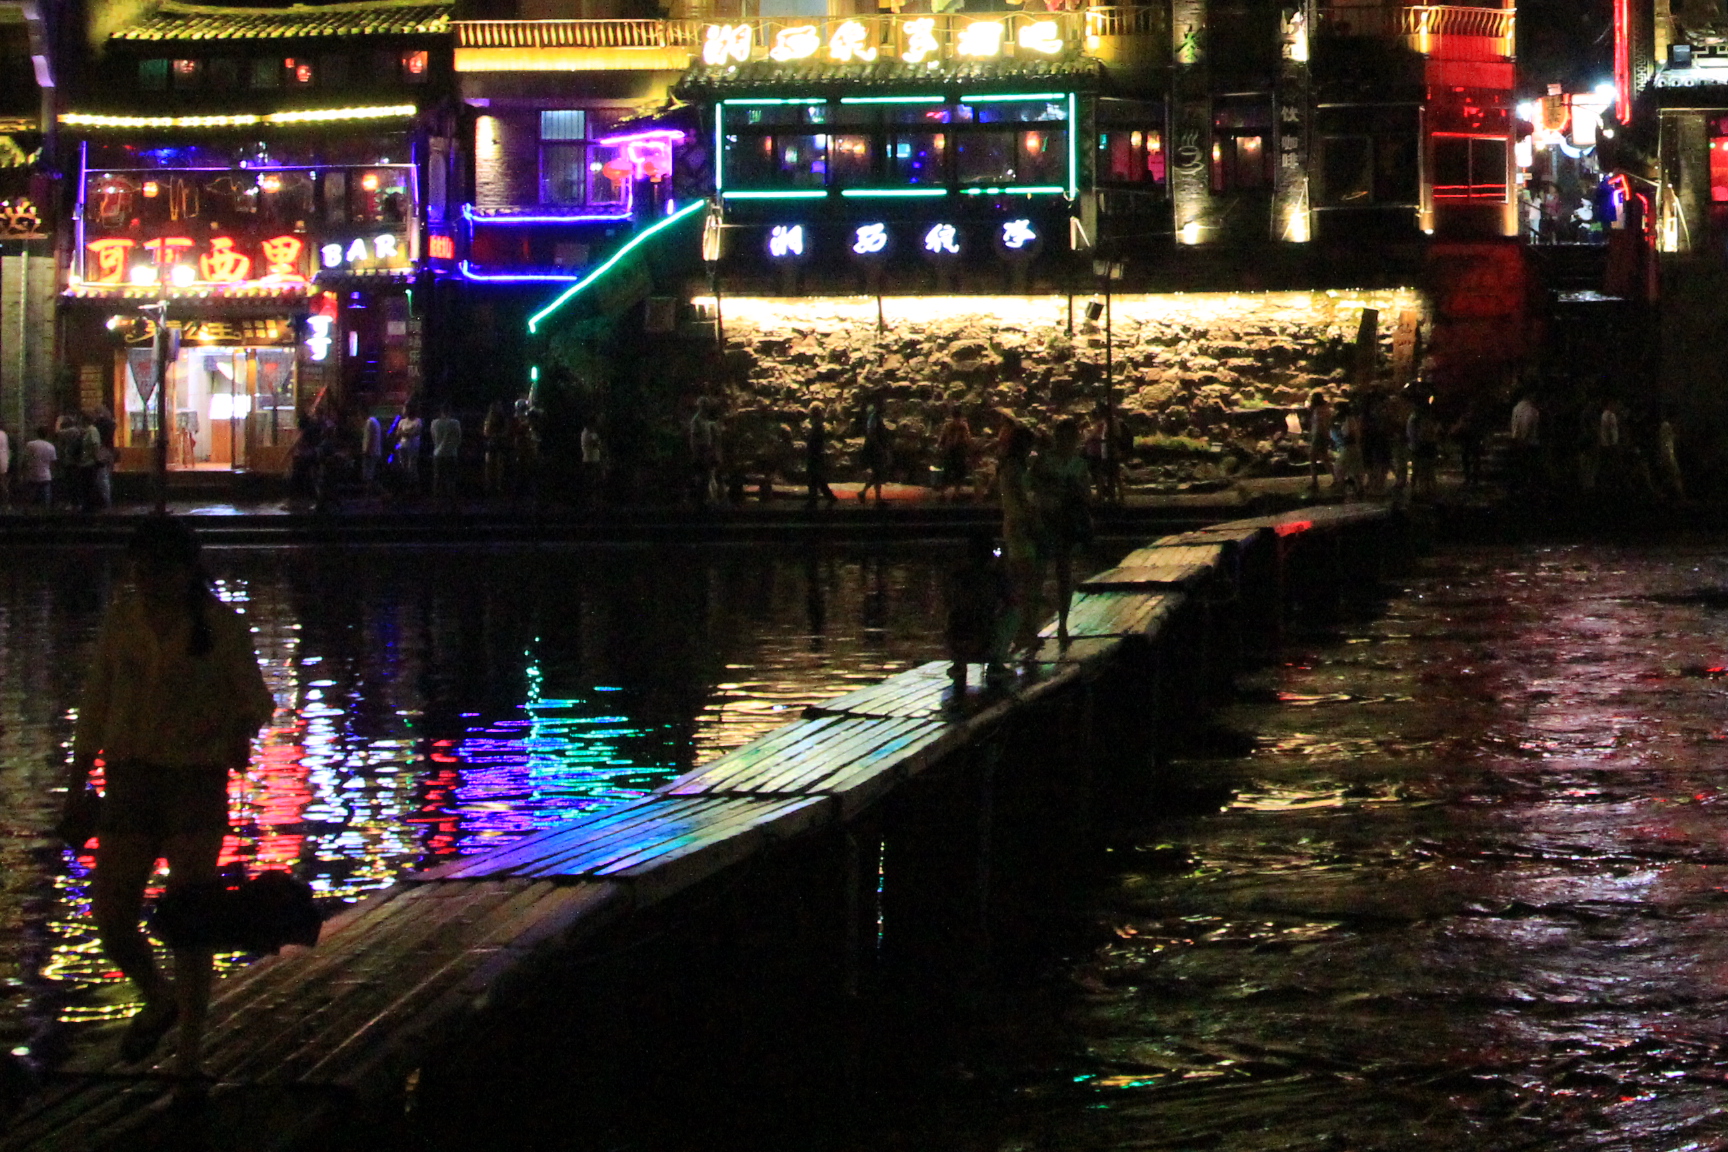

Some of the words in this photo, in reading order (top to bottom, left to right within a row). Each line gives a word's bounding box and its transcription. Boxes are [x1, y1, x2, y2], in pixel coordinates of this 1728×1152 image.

[86, 235, 306, 284] 可可西里
[321, 233, 399, 269] BAR
